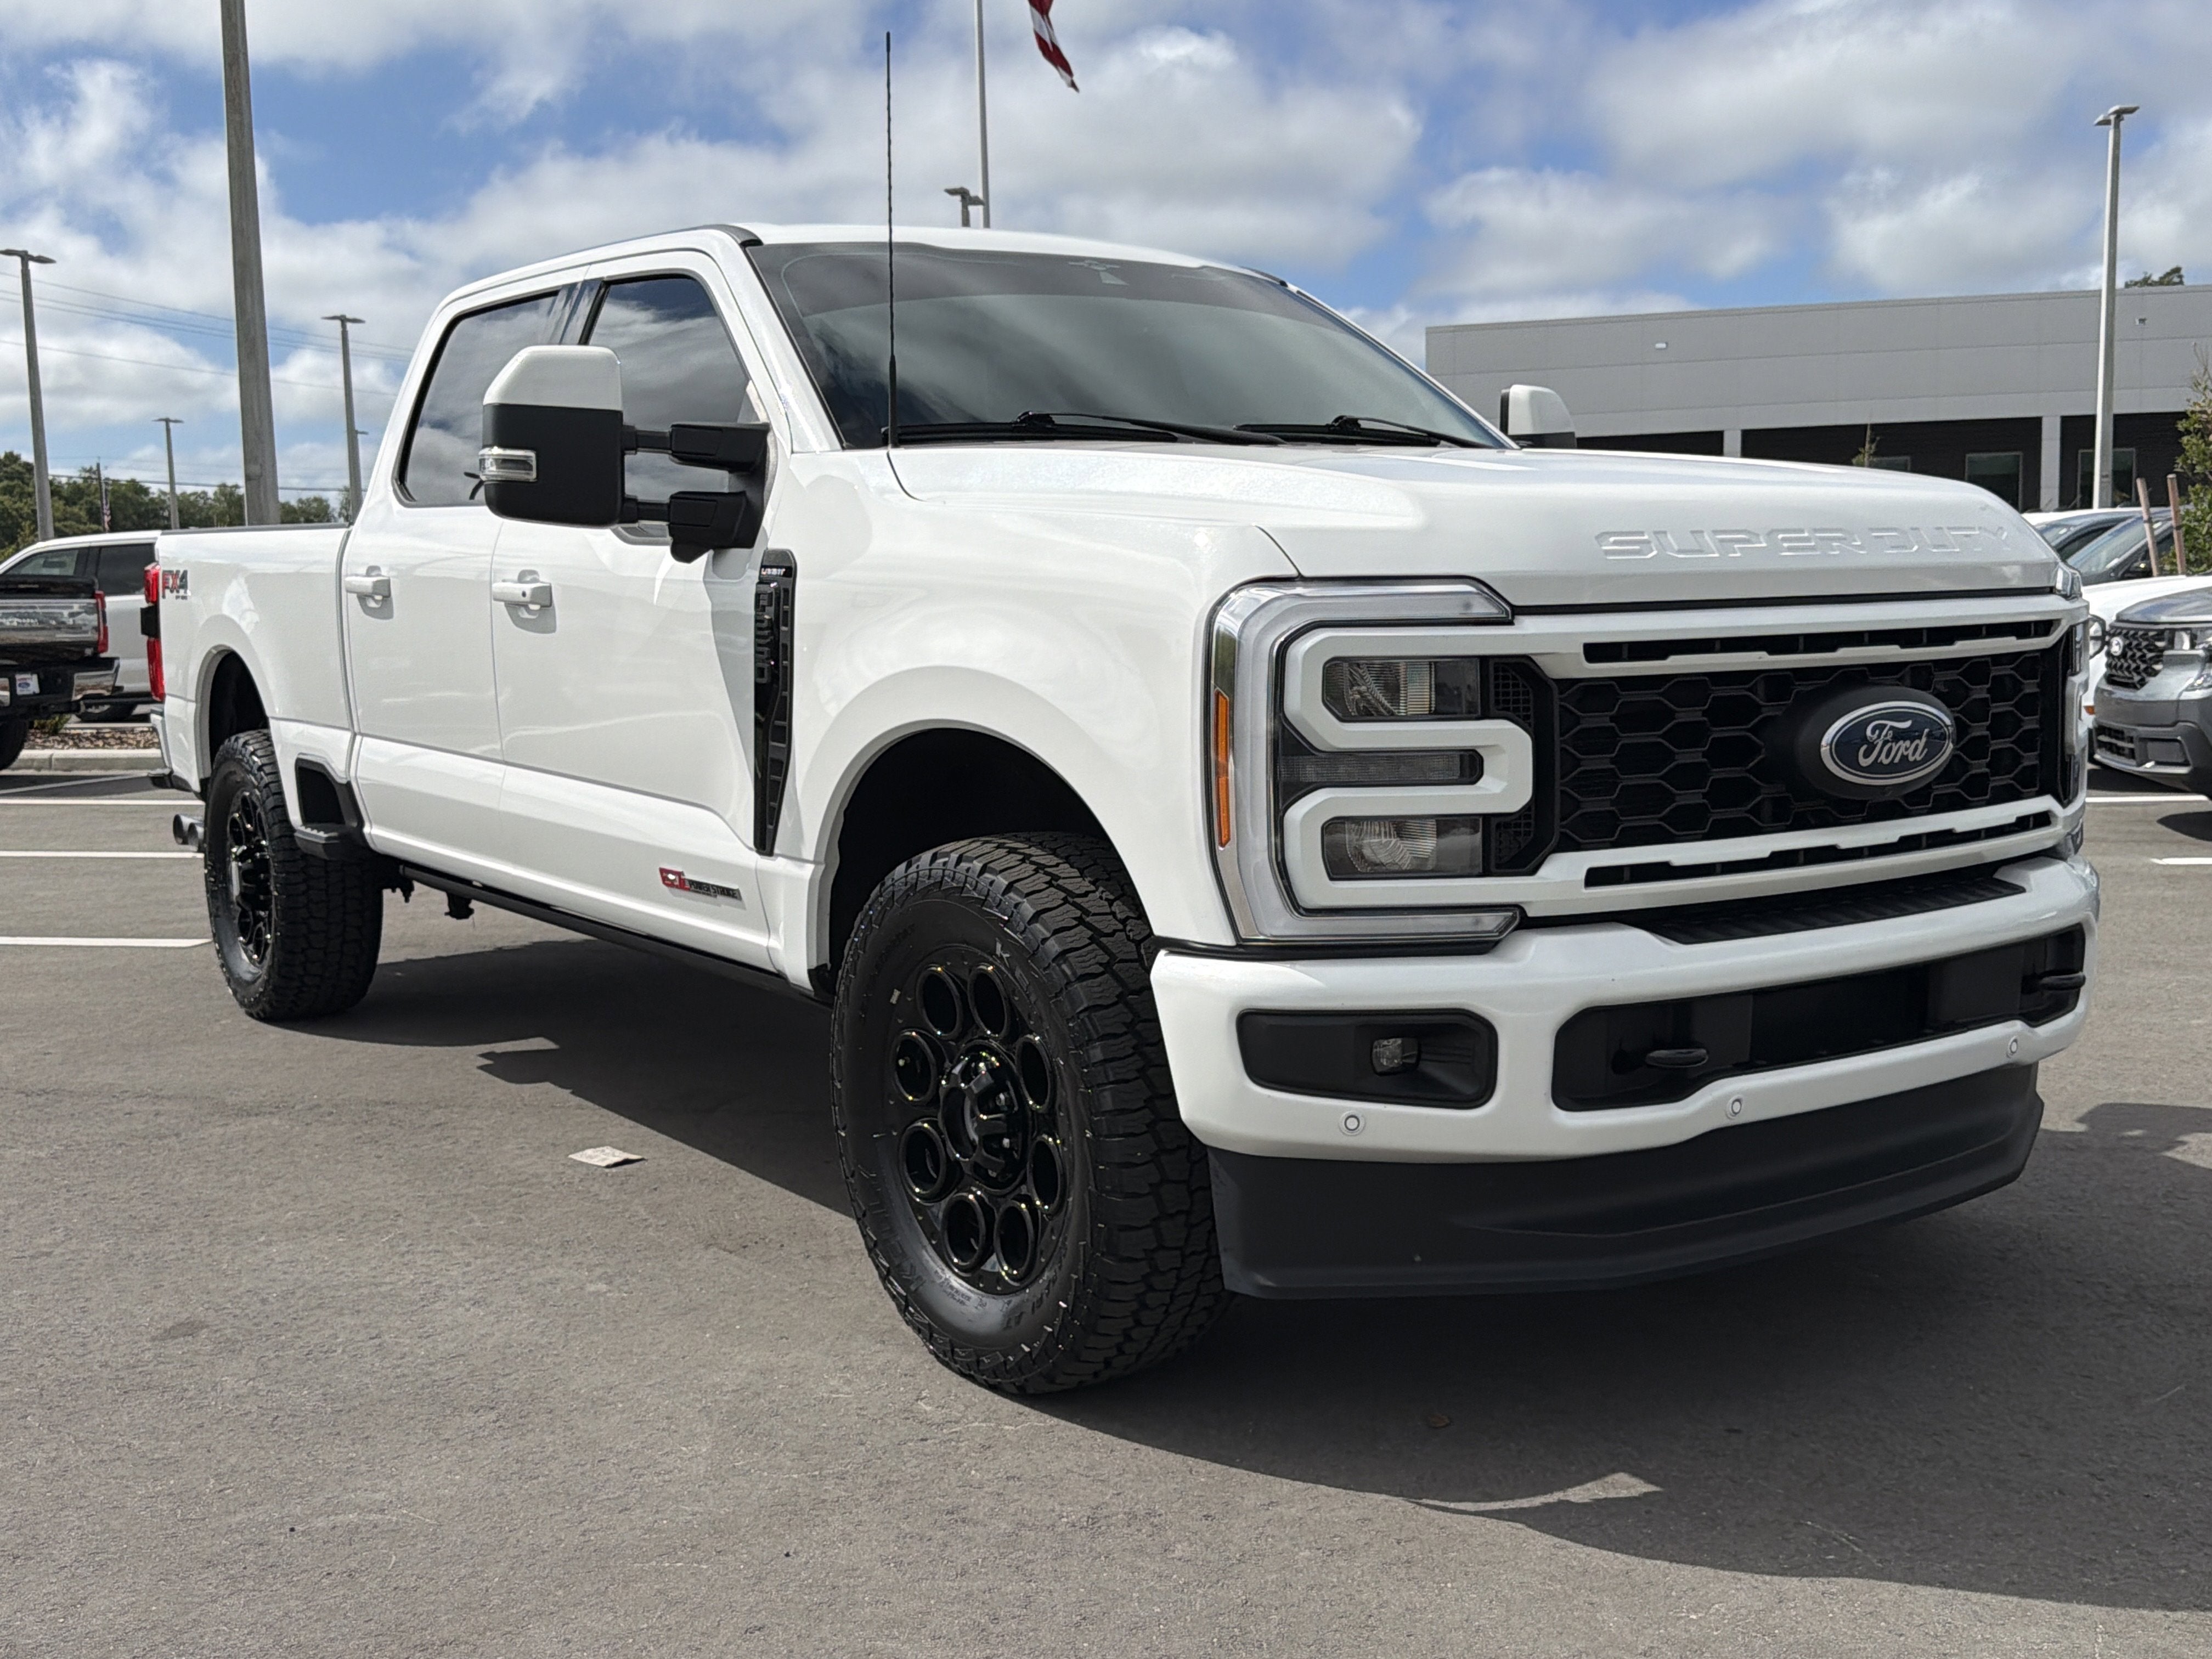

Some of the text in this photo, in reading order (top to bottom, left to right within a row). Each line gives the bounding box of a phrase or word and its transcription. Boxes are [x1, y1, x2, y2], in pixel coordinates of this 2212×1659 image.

[1595, 525, 2011, 559] SUPER DUTY
[162, 569, 188, 599] FX4
[1858, 720, 1929, 766] Ford
